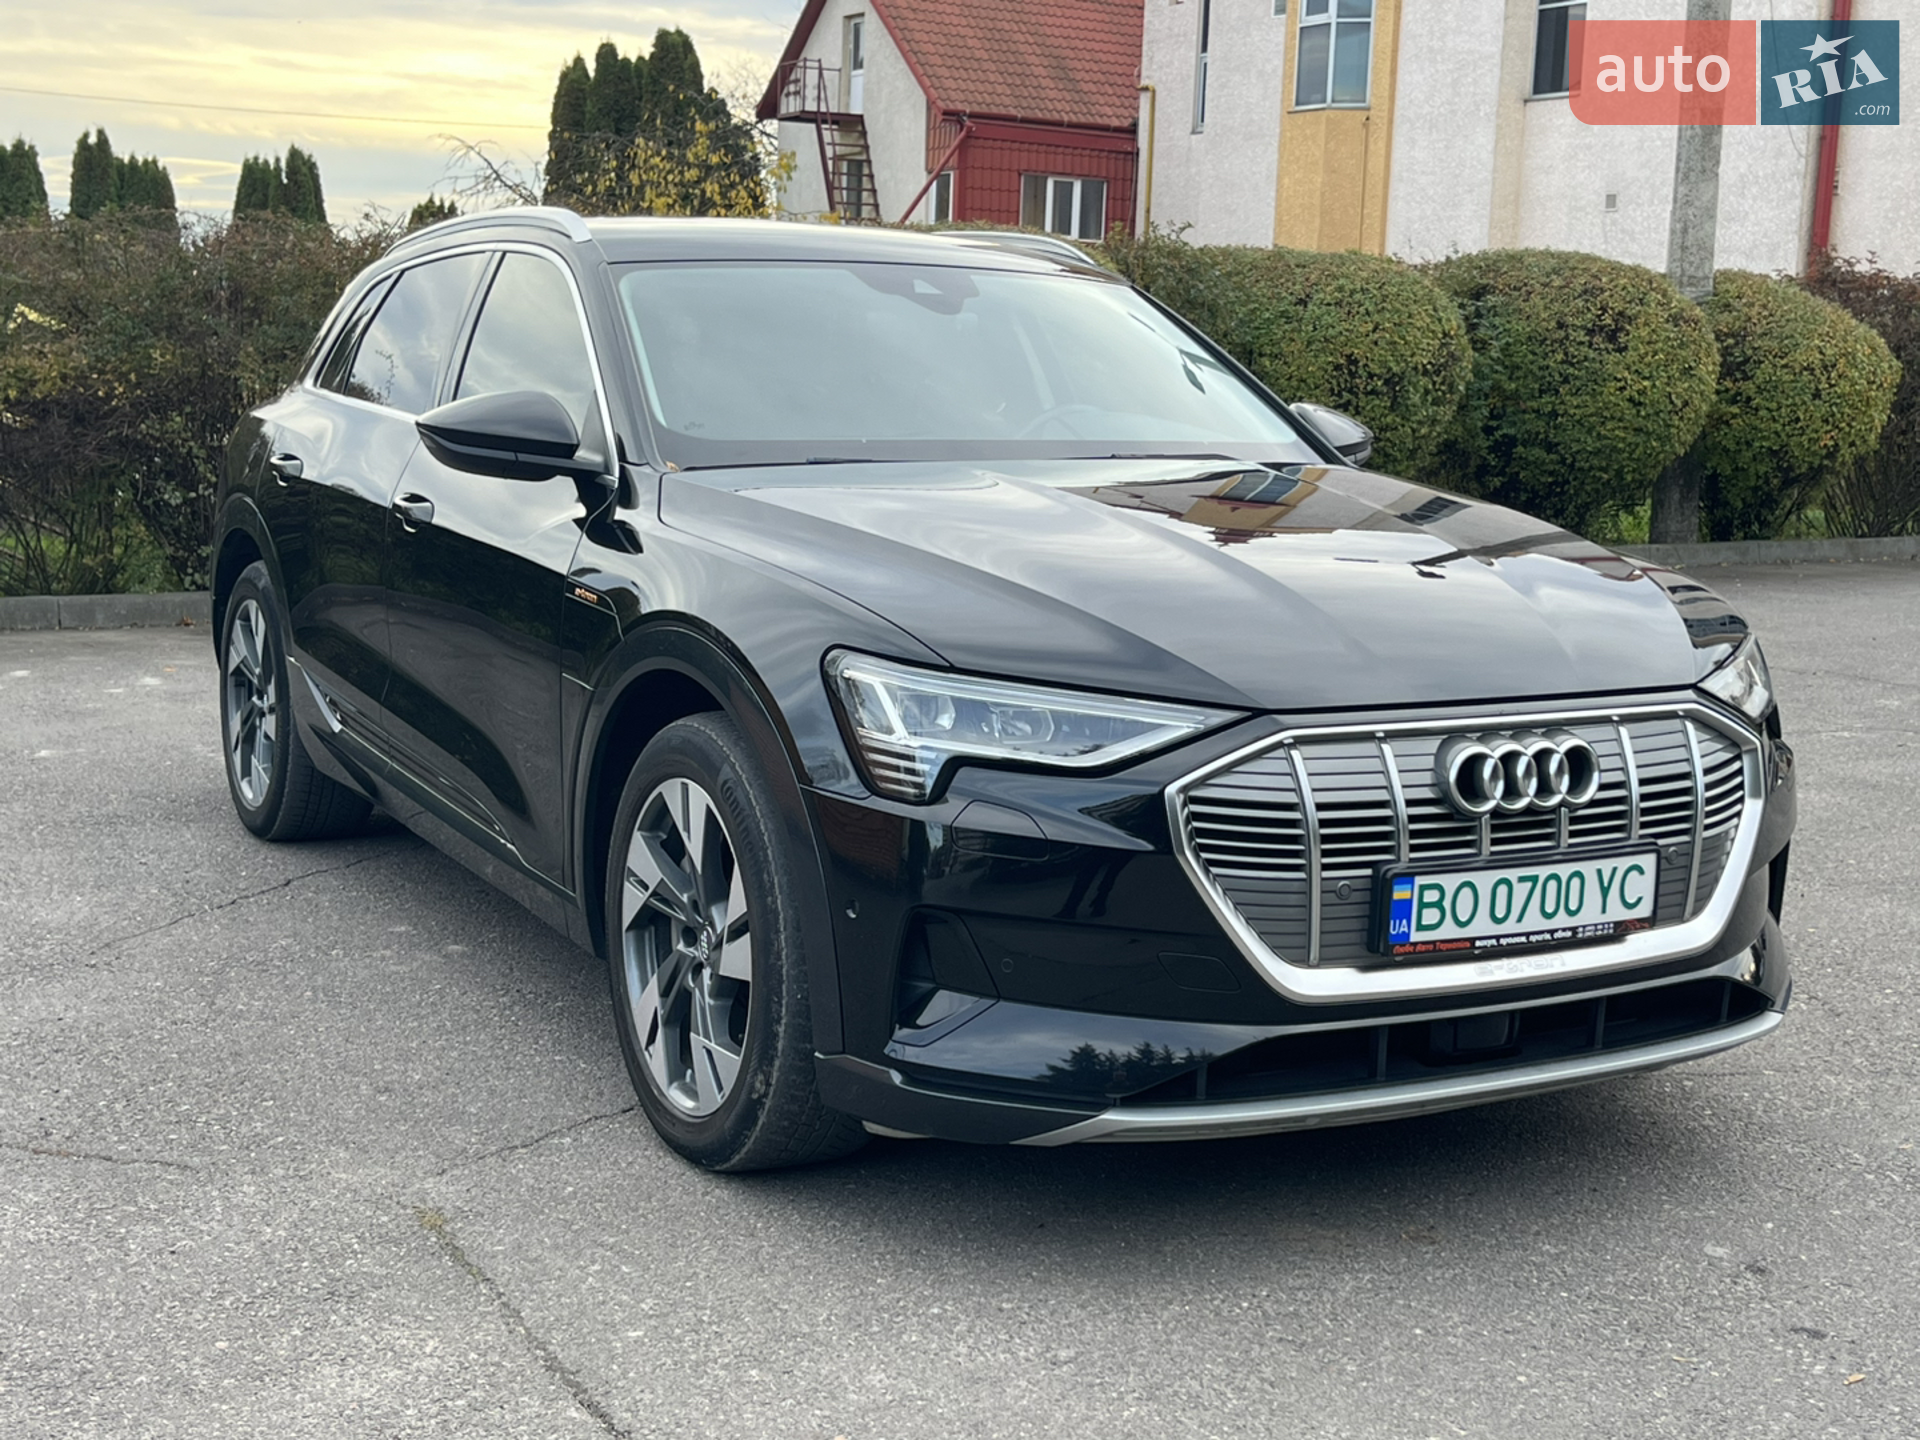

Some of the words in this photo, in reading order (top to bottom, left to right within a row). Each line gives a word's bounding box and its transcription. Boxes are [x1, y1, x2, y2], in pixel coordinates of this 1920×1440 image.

[1415, 880, 1479, 932] BO
[1489, 870, 1586, 925] 0700
[1596, 864, 1645, 914] YC
[1390, 919, 1408, 935] UA
[1474, 955, 1566, 977] e-tron
